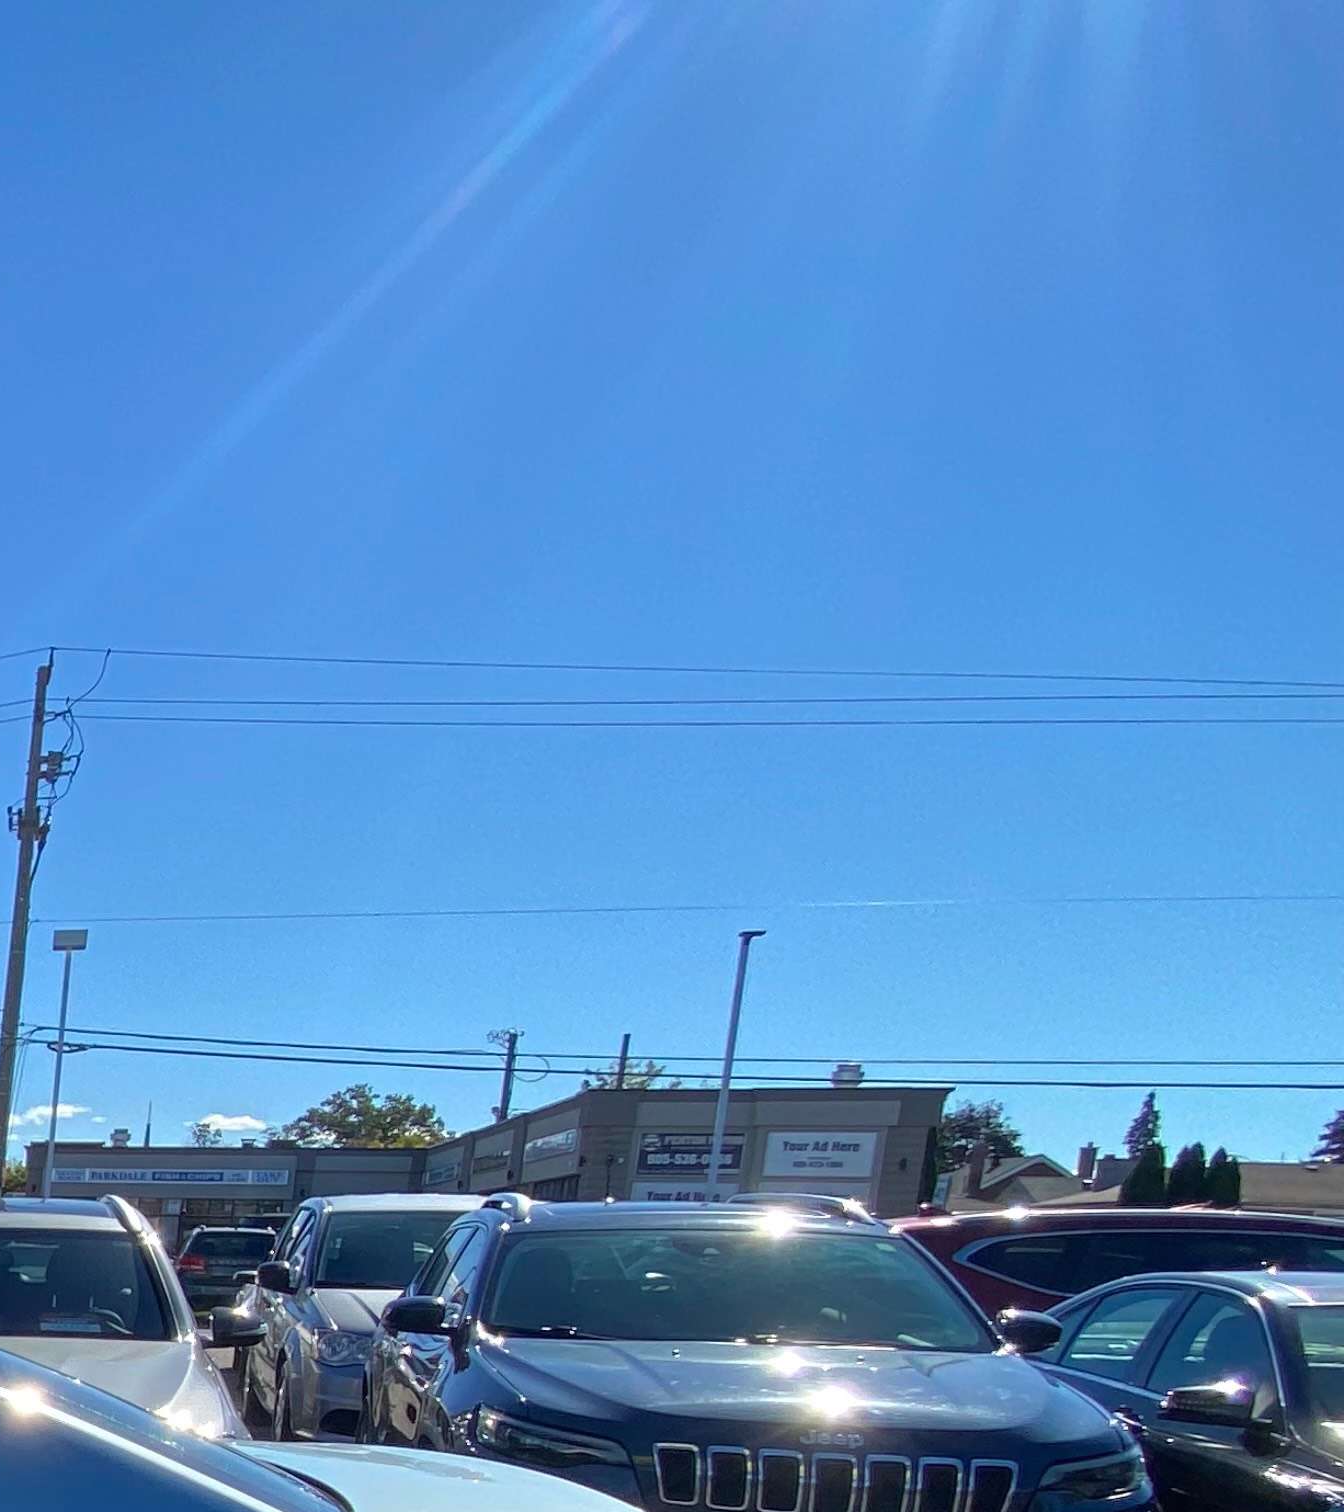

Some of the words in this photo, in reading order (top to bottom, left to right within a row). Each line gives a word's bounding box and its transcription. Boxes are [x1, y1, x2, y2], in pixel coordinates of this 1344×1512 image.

[783, 1141, 810, 1152] Your
[812, 1141, 829, 1152] Ad
[831, 1141, 860, 1152] Here
[800, 1429, 865, 1449] Jeep
